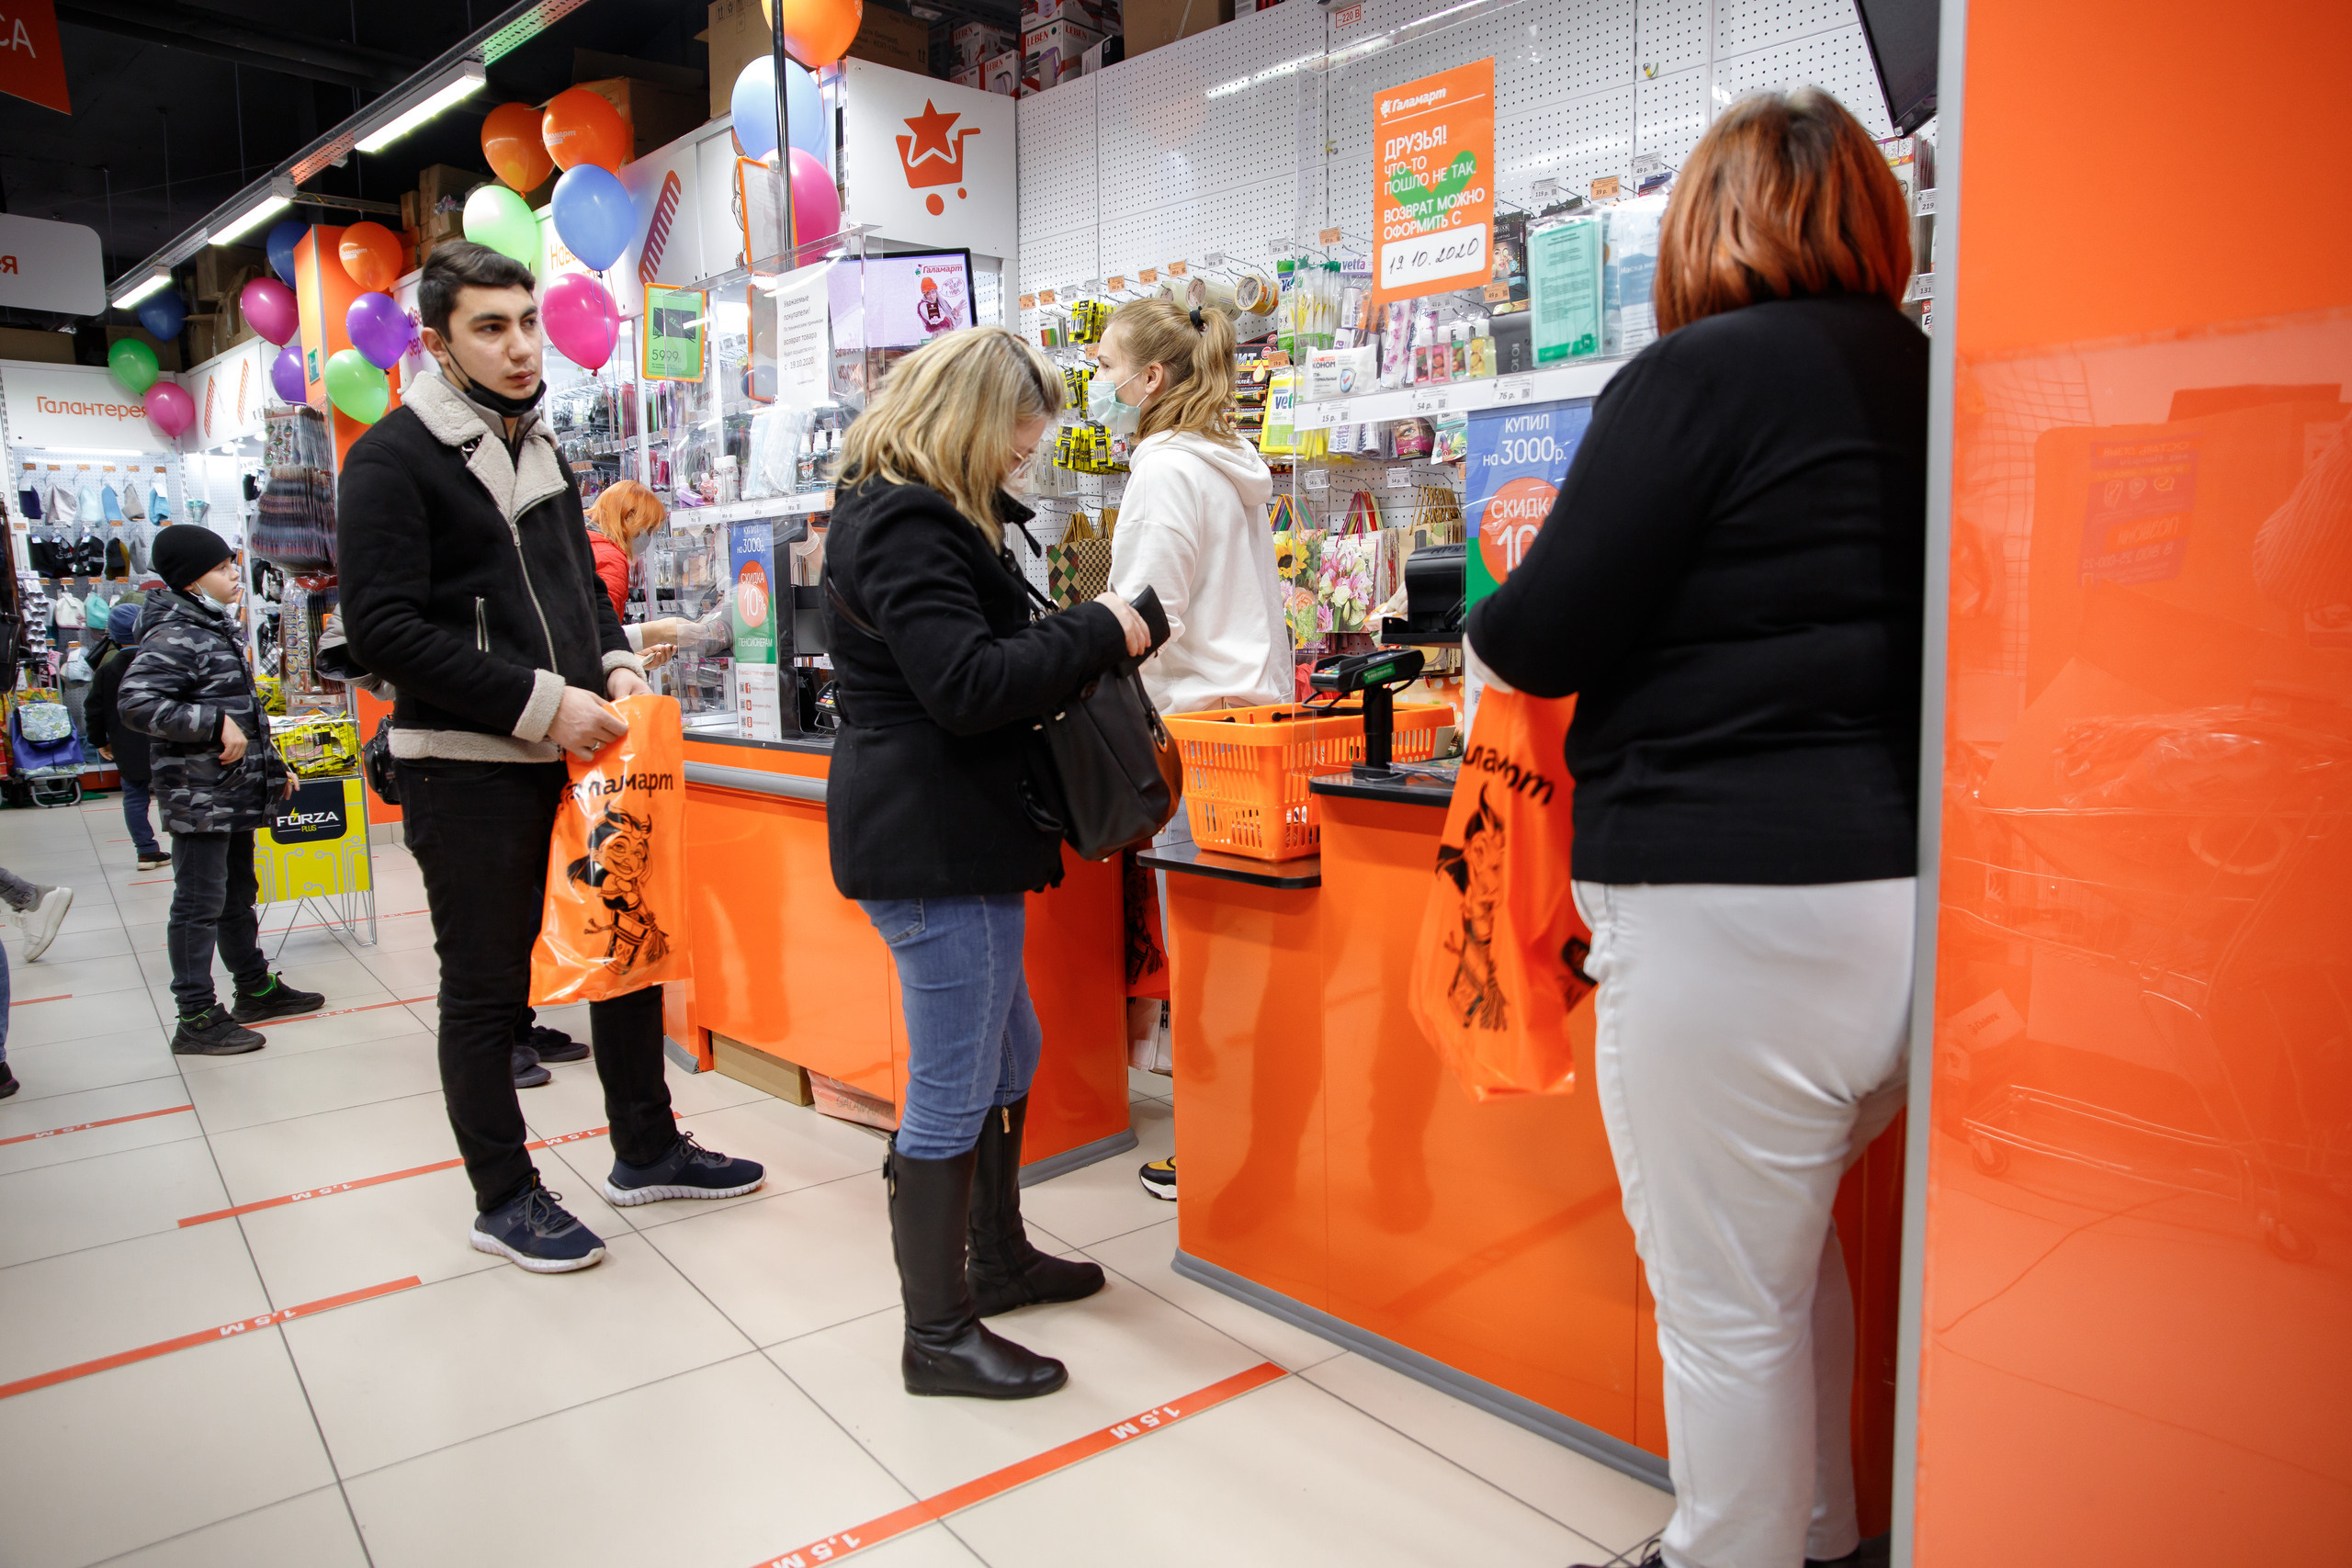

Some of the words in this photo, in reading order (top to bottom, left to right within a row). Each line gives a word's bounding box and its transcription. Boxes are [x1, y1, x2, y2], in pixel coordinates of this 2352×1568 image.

[1027, 29, 1049, 47] LEBEN
[1065, 25, 1087, 39] LEBEN
[1392, 87, 1447, 111] Галамарт
[1385, 125, 1447, 163] ДРУЗЬЯ!
[1385, 155, 1427, 178] ЧТО-ТО
[1385, 172, 1430, 196] ПОШЛО
[1432, 168, 1447, 182] НЕ
[1452, 161, 1476, 179] ТАК.
[1384, 199, 1434, 223] ВОЗВРАТ
[1437, 187, 1486, 211] МОЖНО
[1921, 202, 1935, 210] 219
[1383, 214, 1449, 241] ОФОРМИТЬ
[1453, 210, 1463, 224] С
[923, 265, 963, 275] Галамарт
[1342, 258, 1365, 271] vetta
[1919, 287, 1932, 295] 131
[783, 295, 809, 308] Уважаемые
[801, 332, 818, 342] товара
[1505, 413, 1550, 434] КУПИЛ
[1483, 453, 1498, 467] на
[741, 572, 765, 584] СКИДКА
[743, 587, 766, 617] 10%
[738, 637, 774, 648] ПЕНСИОНЕРАМ
[277, 810, 339, 827] FORZA
[301, 824, 318, 832] PLUS
[1139, 1406, 1181, 1427] 1,5
[810, 1532, 862, 1561] 1,5
